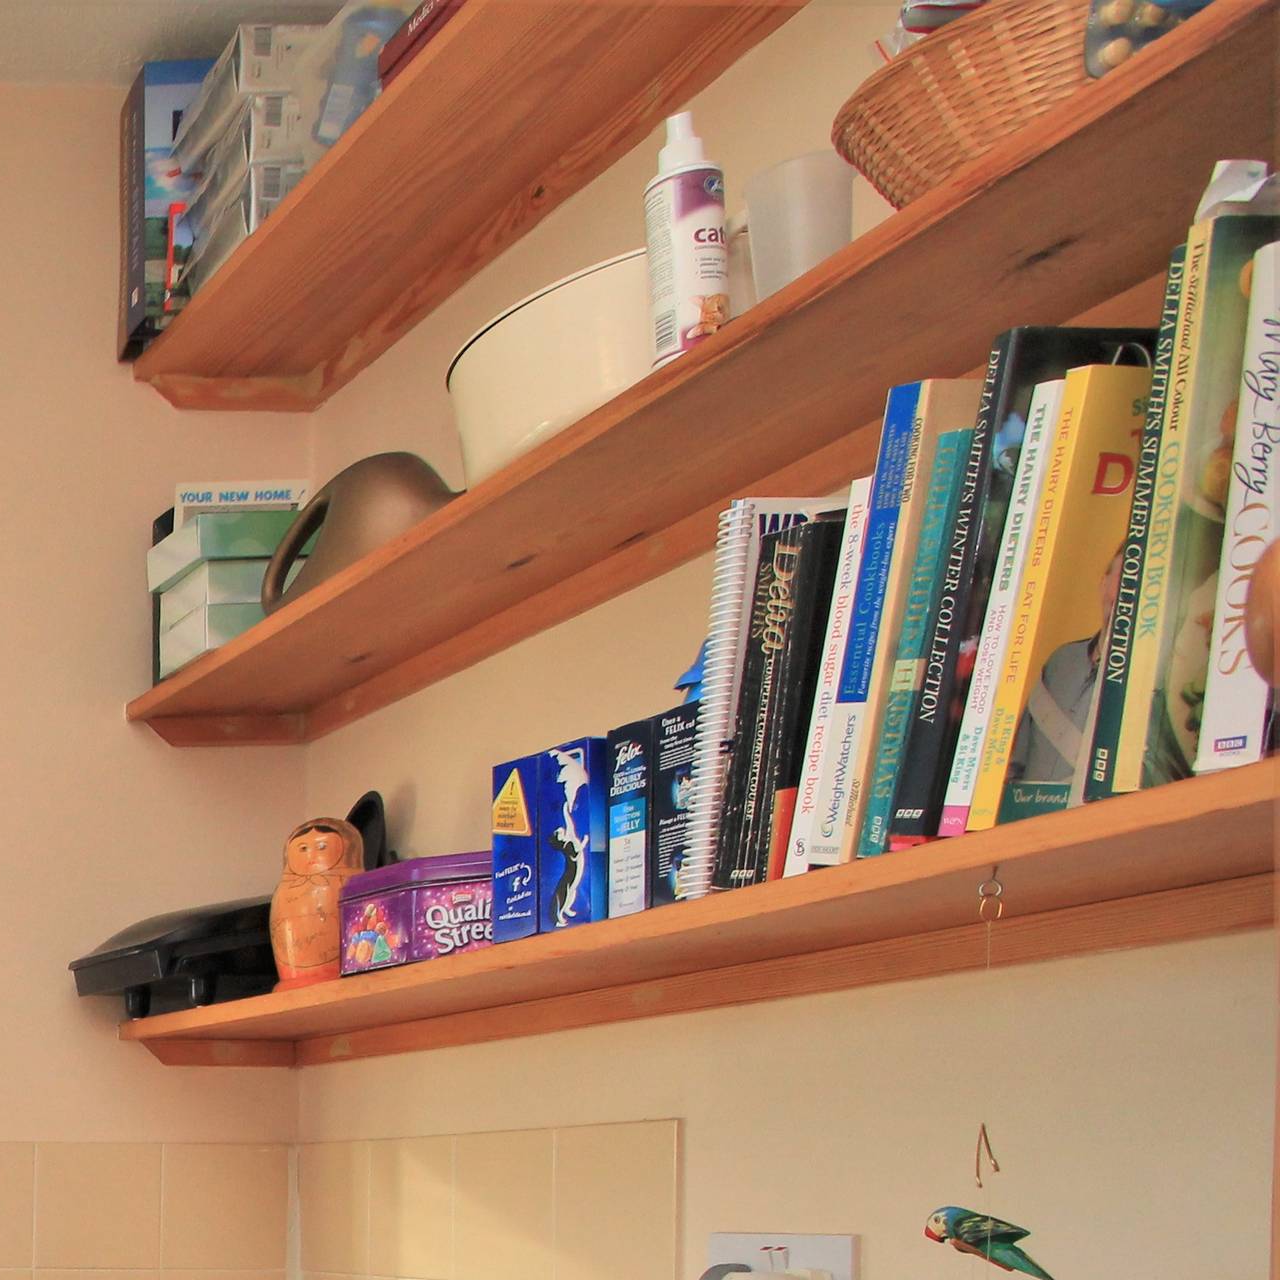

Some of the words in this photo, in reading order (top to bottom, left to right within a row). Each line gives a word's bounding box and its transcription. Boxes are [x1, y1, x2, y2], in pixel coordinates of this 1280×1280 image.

[1160, 261, 1184, 331] DELIA
[979, 350, 1000, 413] DELIA
[1031, 404, 1047, 443] THE
[1060, 408, 1074, 447] THE
[1015, 448, 1038, 506] HAIRY
[1049, 447, 1065, 494] HAIRY
[1092, 452, 1134, 497] D
[1126, 435, 1159, 540] SUMMER
[1234, 420, 1280, 508] Berry
[180, 491, 212, 502] YOUR
[219, 491, 249, 502] NEW
[255, 489, 292, 500] HOME
[851, 503, 864, 532] the
[944, 505, 970, 591] WINTER
[998, 512, 1024, 592] DIETERS
[1032, 499, 1054, 568] DIETERS
[841, 534, 860, 588] 8-week
[761, 541, 802, 655] Delia
[831, 592, 848, 638] blood
[843, 621, 868, 696] Essential
[857, 521, 886, 616] Cookbooks
[1023, 580, 1036, 610] EAT
[1106, 543, 1142, 684] COLLECTION
[1138, 561, 1165, 638] BOOK
[1017, 615, 1030, 647] FOR
[820, 641, 838, 689] sugar
[919, 596, 955, 723] COLLECTION
[1006, 650, 1022, 683] LIFE
[758, 658, 775, 720] COMPLETE
[816, 691, 833, 722] diet
[665, 721, 685, 736] FELIX
[808, 725, 825, 772] recipe
[972, 727, 983, 755] Dave
[610, 779, 647, 798] DELICIOUS
[827, 714, 857, 825] WeightWatchers
[745, 777, 760, 820] COURSE
[801, 775, 817, 815] book
[426, 899, 491, 929] Quali
[434, 922, 493, 954] Stree
